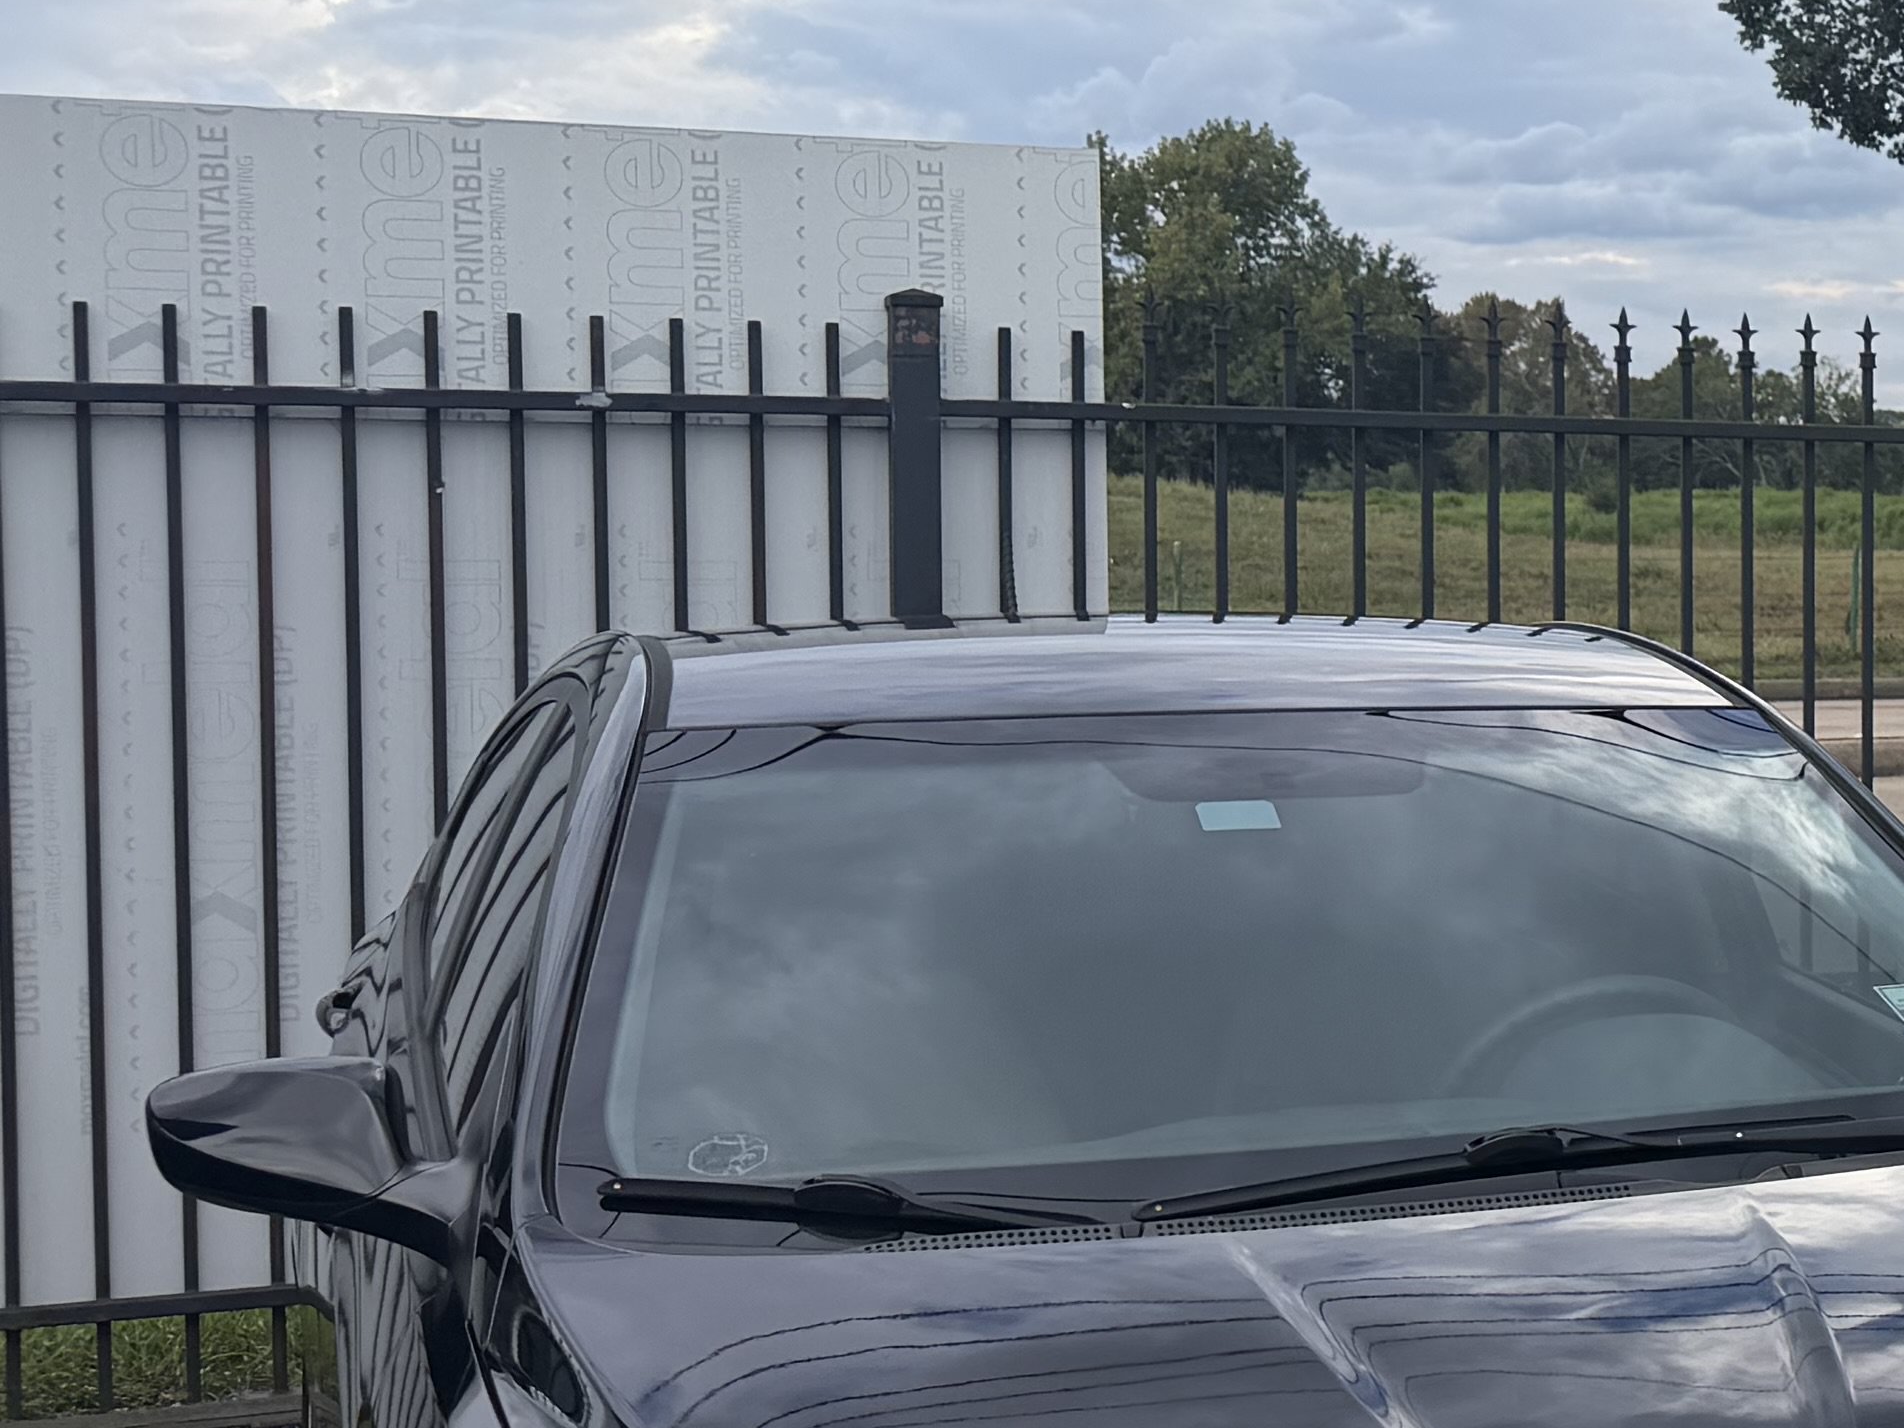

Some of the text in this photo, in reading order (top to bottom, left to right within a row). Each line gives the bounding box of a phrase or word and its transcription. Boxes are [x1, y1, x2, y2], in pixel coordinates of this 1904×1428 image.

[197, 124, 233, 298] PRINTABLE
[235, 155, 255, 231] PRINTING
[236, 235, 256, 268] FOR
[451, 138, 485, 305] PRINTABLE
[487, 166, 509, 366] OPTIMIZED FOR PRINTING
[691, 148, 722, 313] PRINTABLE
[725, 177, 746, 371] OPTIMIZED FOR PRINTING
[916, 159, 946, 293] RINTABLE
[949, 187, 970, 376] OPTIMIZED FOR PRINTING
